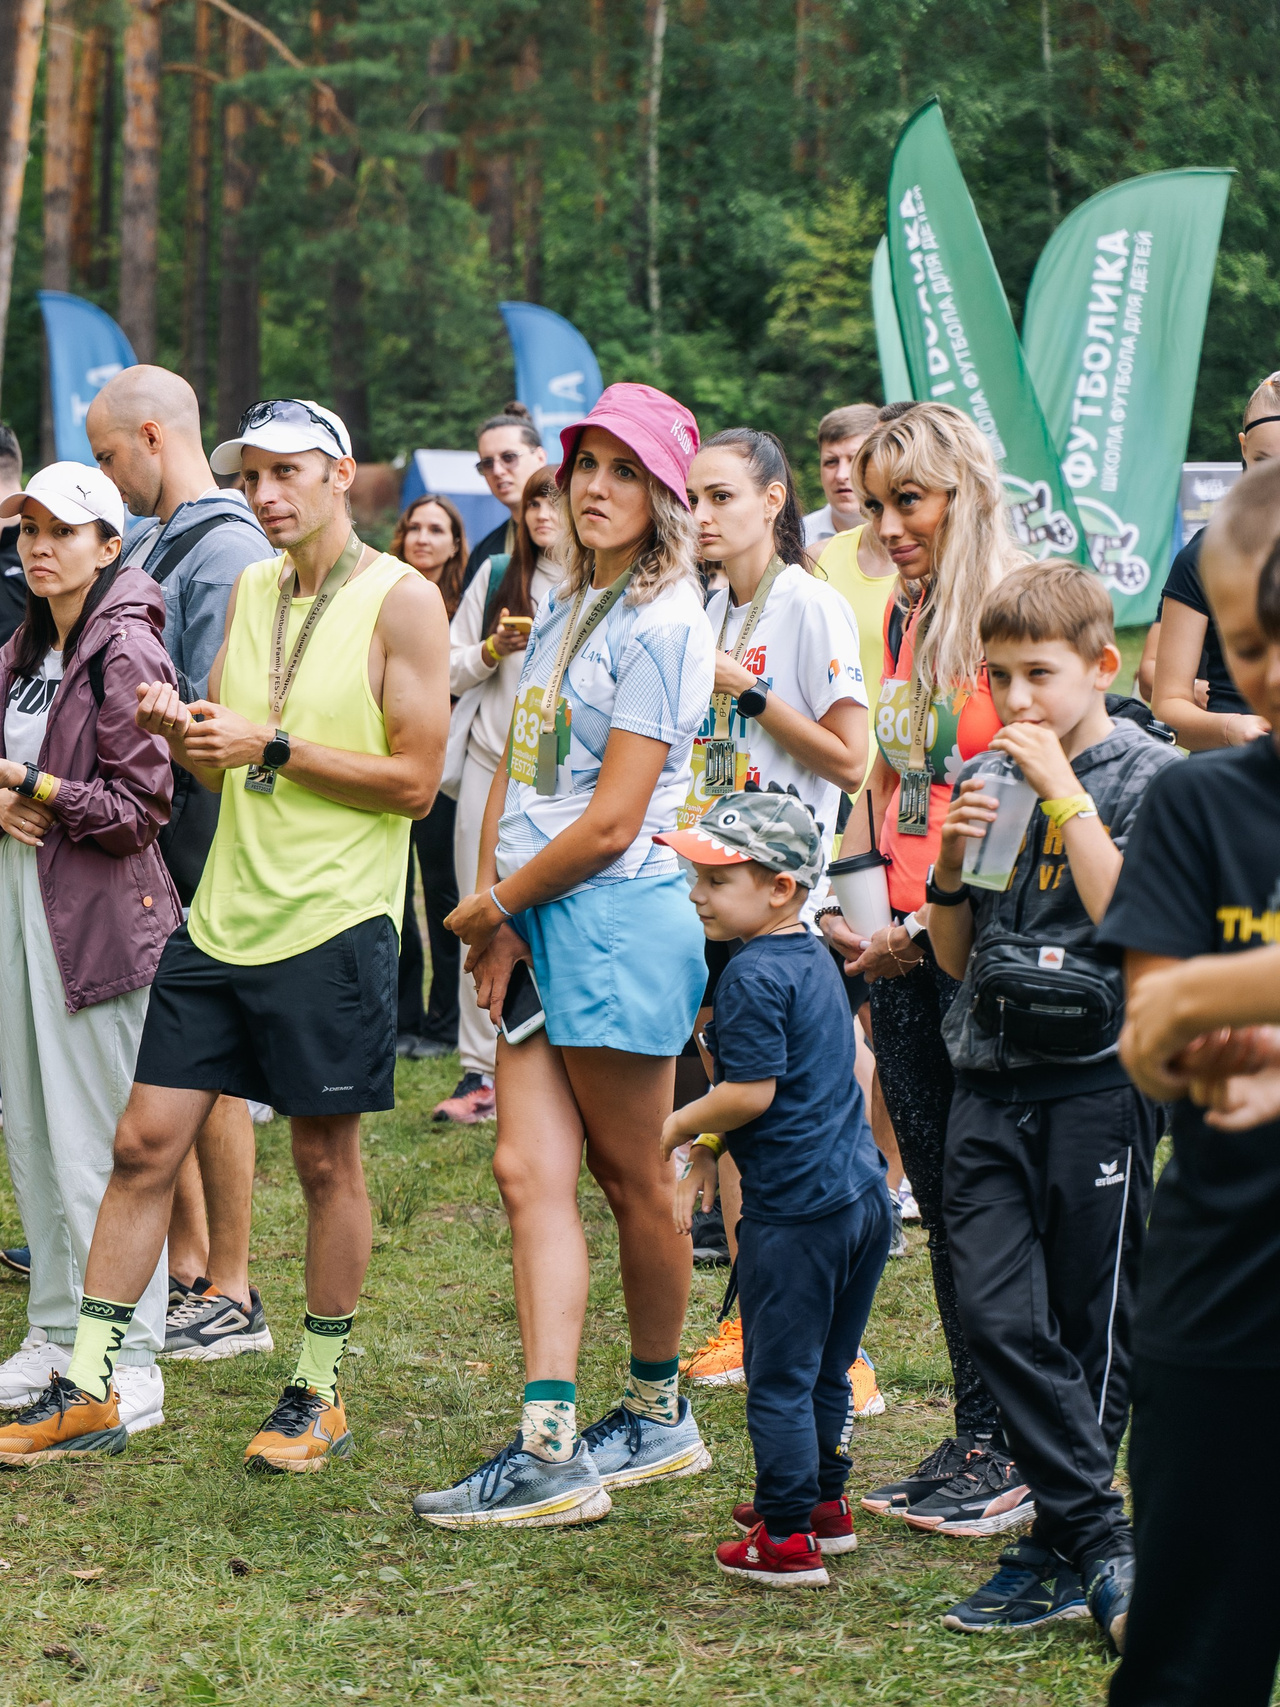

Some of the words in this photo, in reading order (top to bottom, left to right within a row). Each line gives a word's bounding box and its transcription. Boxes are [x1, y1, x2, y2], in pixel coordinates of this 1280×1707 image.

[924, 252, 954, 295] ДЛЯ
[1129, 230, 1154, 293] ДЕТЕЙ
[1123, 293, 1143, 334] ДЛЯ
[938, 295, 980, 390] ФУТБОЛА
[1061, 228, 1130, 488] ФУТБОЛИКА
[1110, 336, 1137, 422] ФУТБОЛА
[1100, 425, 1124, 492] ШКОЛА
[276, 605, 288, 645] Footbolika
[586, 590, 613, 627] FEST2025
[279, 659, 297, 700] Footbolika
[294, 632, 308, 658] Family
[305, 593, 328, 630] FEST2025
[734, 642, 744, 661] amily
[741, 606, 759, 640] FEST2025
[273, 646, 282, 673] Family
[843, 662, 863, 682] СБ
[546, 669, 559, 709] FEST2025
[513, 707, 545, 749] 83
[511, 756, 538, 778] FEST20
[677, 809, 701, 826] 2025
[685, 804, 704, 814] Family
[1216, 905, 1280, 945] TH
